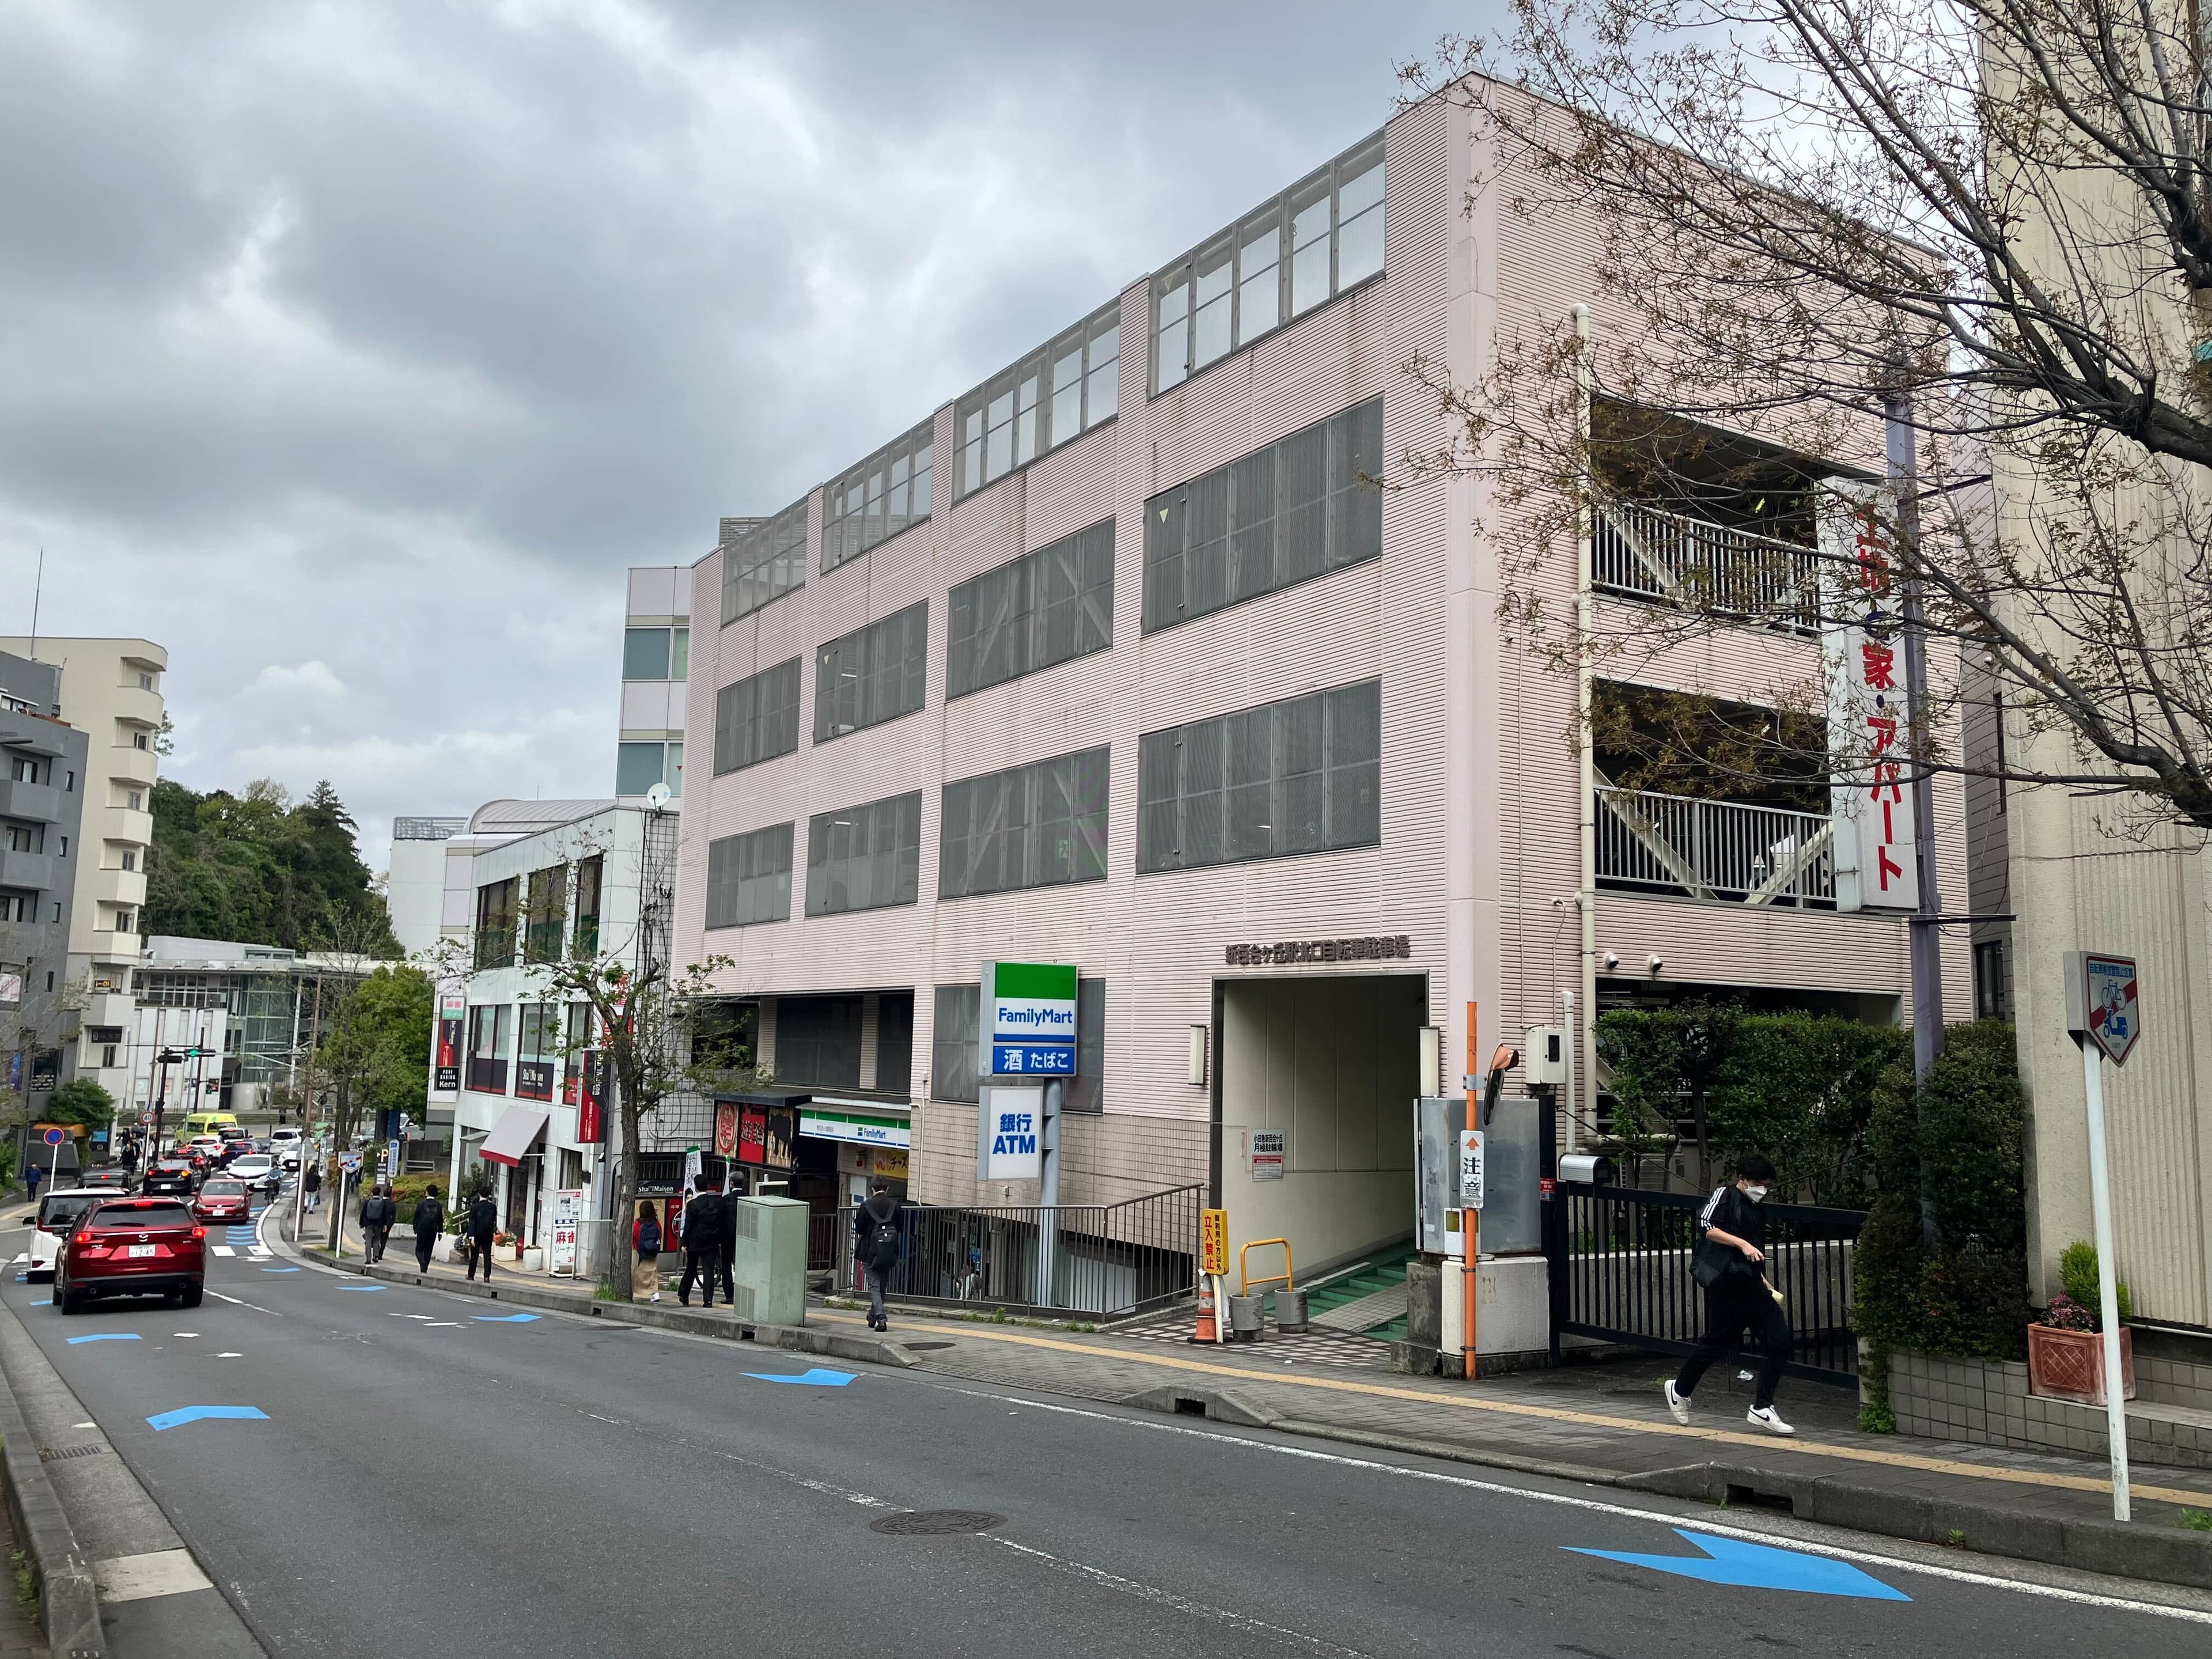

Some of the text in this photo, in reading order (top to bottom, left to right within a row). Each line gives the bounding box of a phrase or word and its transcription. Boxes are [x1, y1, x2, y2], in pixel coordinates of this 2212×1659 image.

[998, 1007, 1073, 1027] FamilyMart
[1003, 1049, 1069, 1071] 酒 たばこ
[531, 1070, 544, 1082] Mason
[999, 1113, 1032, 1132] 銀行
[864, 1128, 886, 1139] FamilyMart
[992, 1135, 1035, 1154] ATM
[381, 1148, 389, 1162] P
[1464, 1157, 1481, 1198] 注意
[555, 1230, 574, 1244] 麻雀
[1205, 1215, 1214, 1270] 立入禁止
